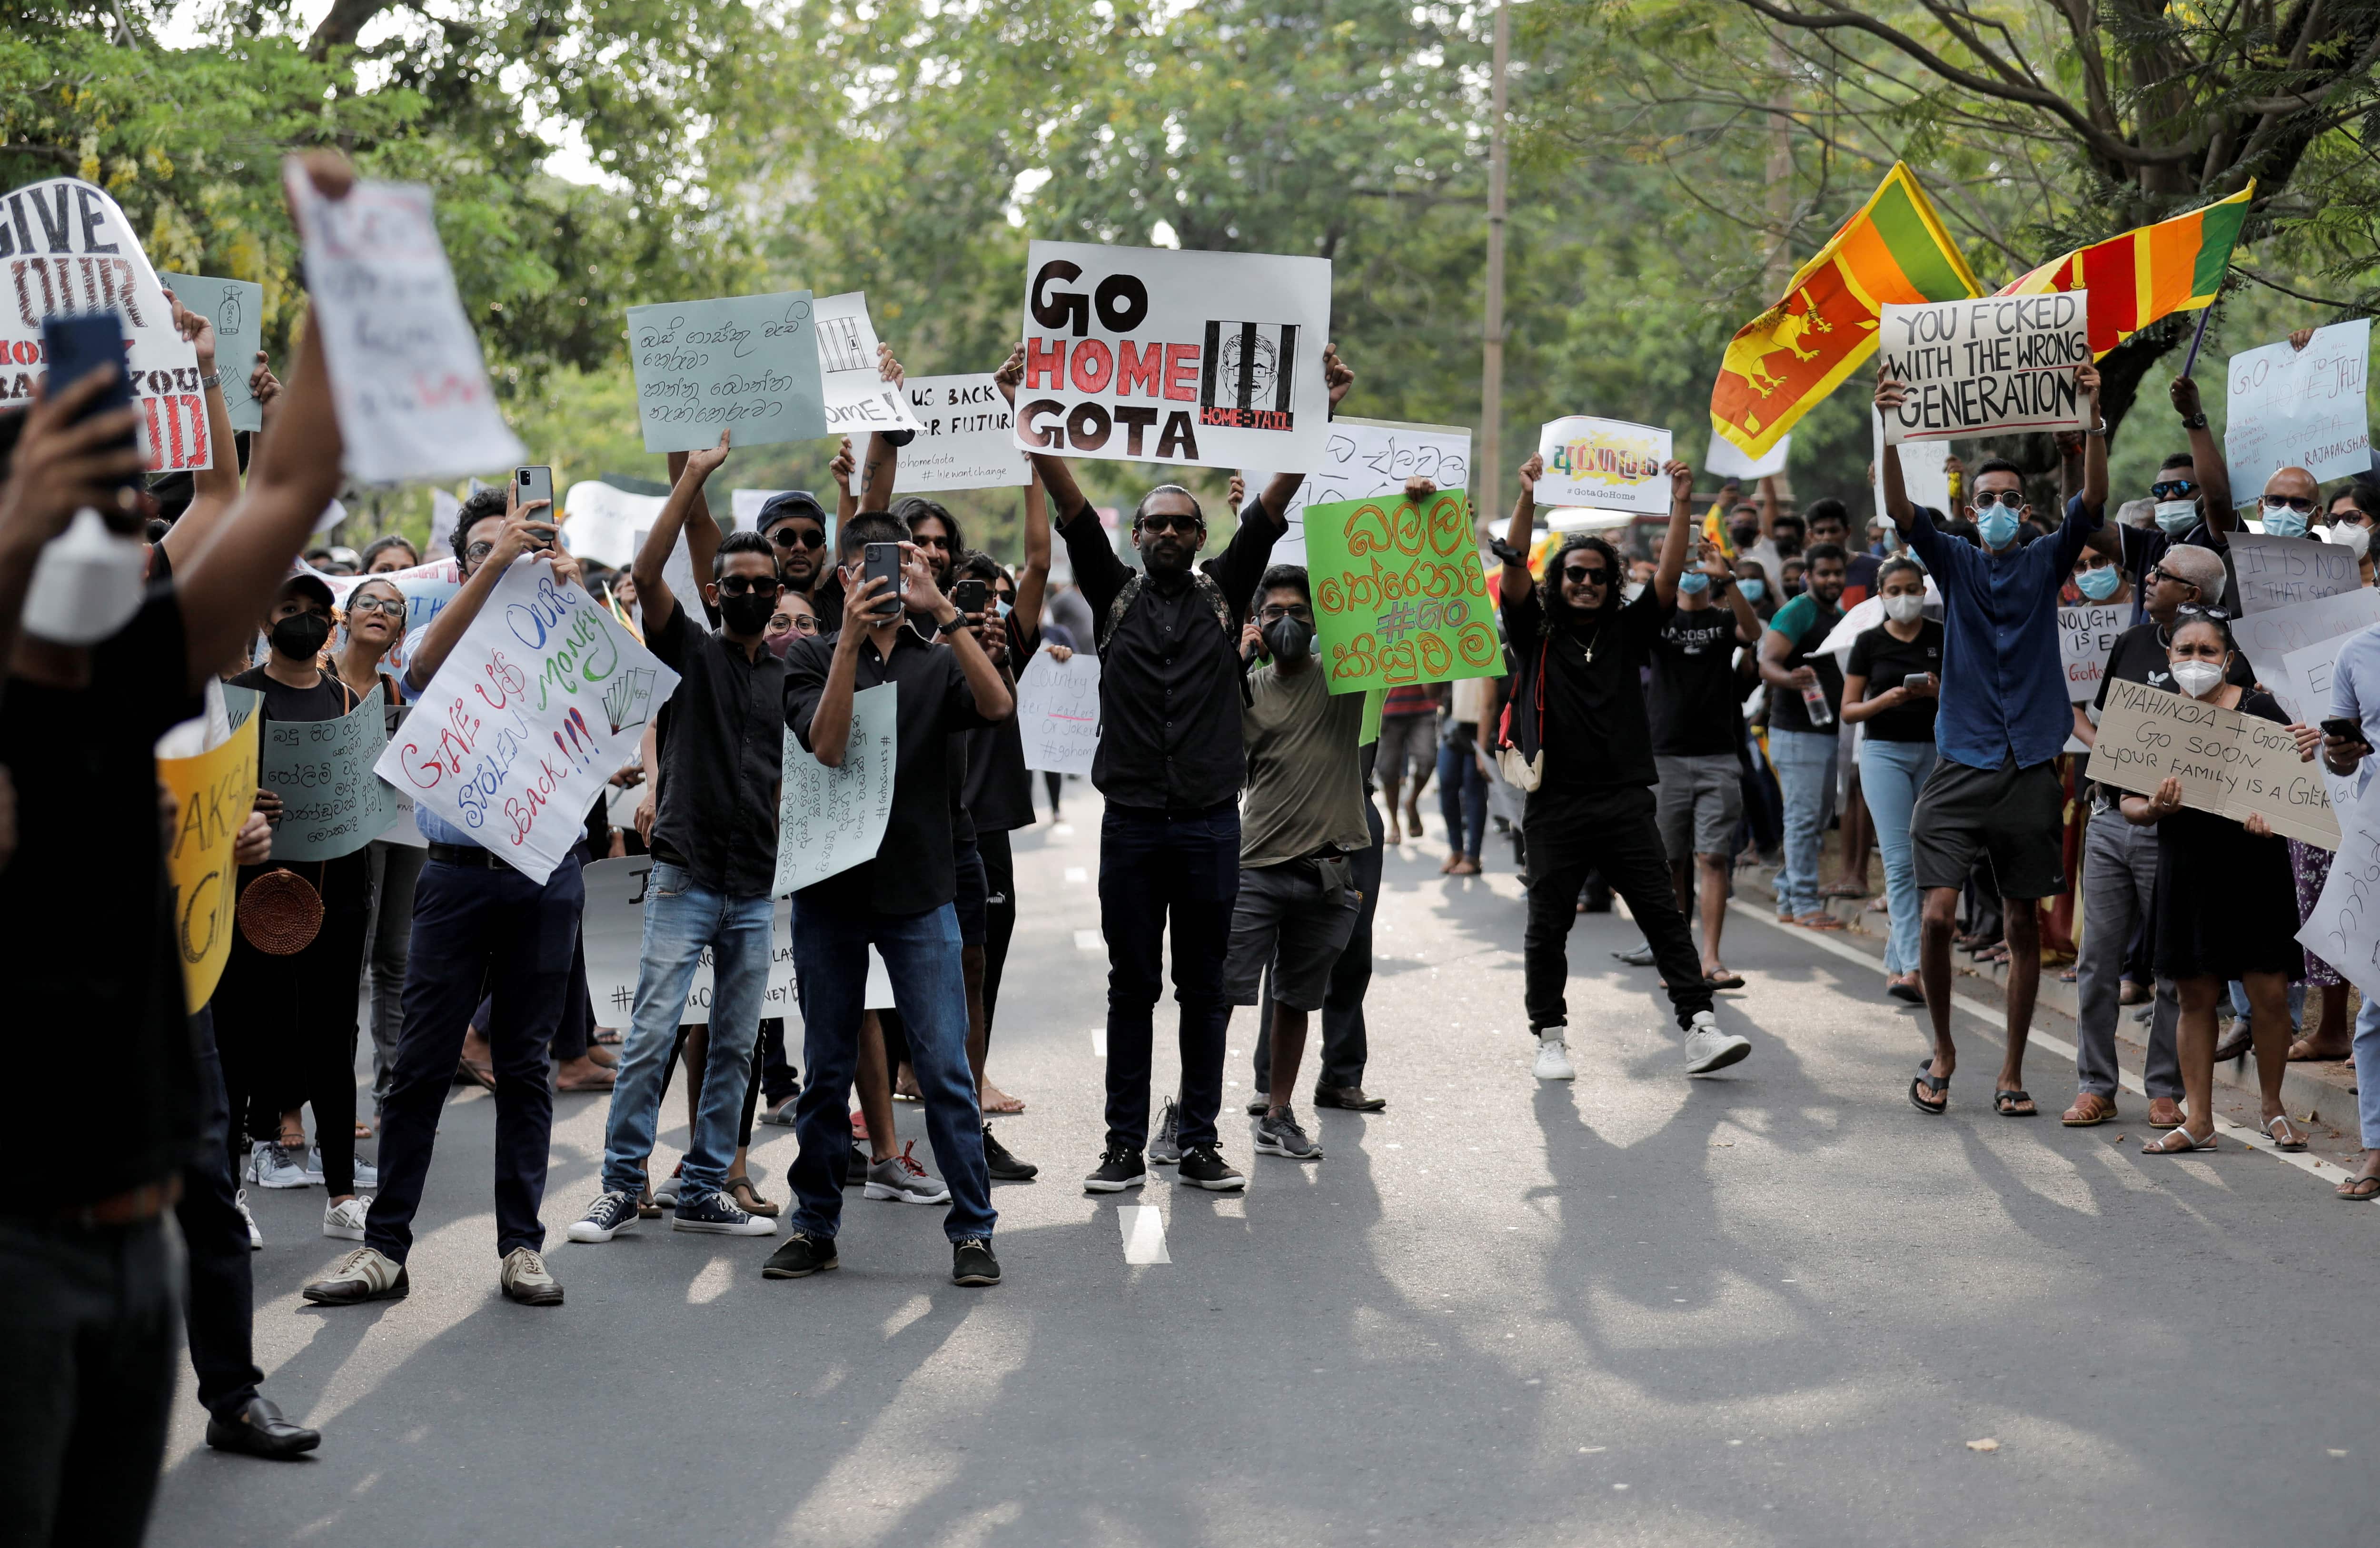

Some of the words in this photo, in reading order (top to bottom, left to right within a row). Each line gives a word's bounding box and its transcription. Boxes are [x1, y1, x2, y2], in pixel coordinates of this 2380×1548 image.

[1030, 259, 1148, 337] GO
[1896, 307, 1957, 345] YOU
[1026, 337, 1200, 402] HOME
[1888, 345, 1953, 382] WITH
[1963, 337, 2012, 377] THE
[2016, 331, 2085, 369] WRONG
[912, 388, 934, 406] US
[948, 385, 995, 405] BACK
[1897, 367, 2077, 428] GENERATION
[916, 419, 941, 436] UR
[952, 413, 1014, 433] FUTUR
[1016, 398, 1199, 460] GOTA
[897, 453, 954, 468] ohomeGota
[2243, 546, 2268, 574] IT
[2283, 548, 2306, 576] IS
[2315, 553, 2353, 579] NOT
[2262, 582, 2304, 602] THAT
[2057, 609, 2118, 631] NOUGH
[401, 697, 480, 788] GIVE
[506, 577, 576, 650] OUR
[2069, 661, 2106, 681] GoHo
[2110, 682, 2216, 728] MAHINDA
[2253, 727, 2299, 754] GOTA
[2136, 721, 2171, 749] GO
[458, 709, 528, 828] STOLEN
[2170, 758, 2238, 793] FAMILY
[2246, 779, 2263, 794] IS
[2269, 786, 2281, 800] A
